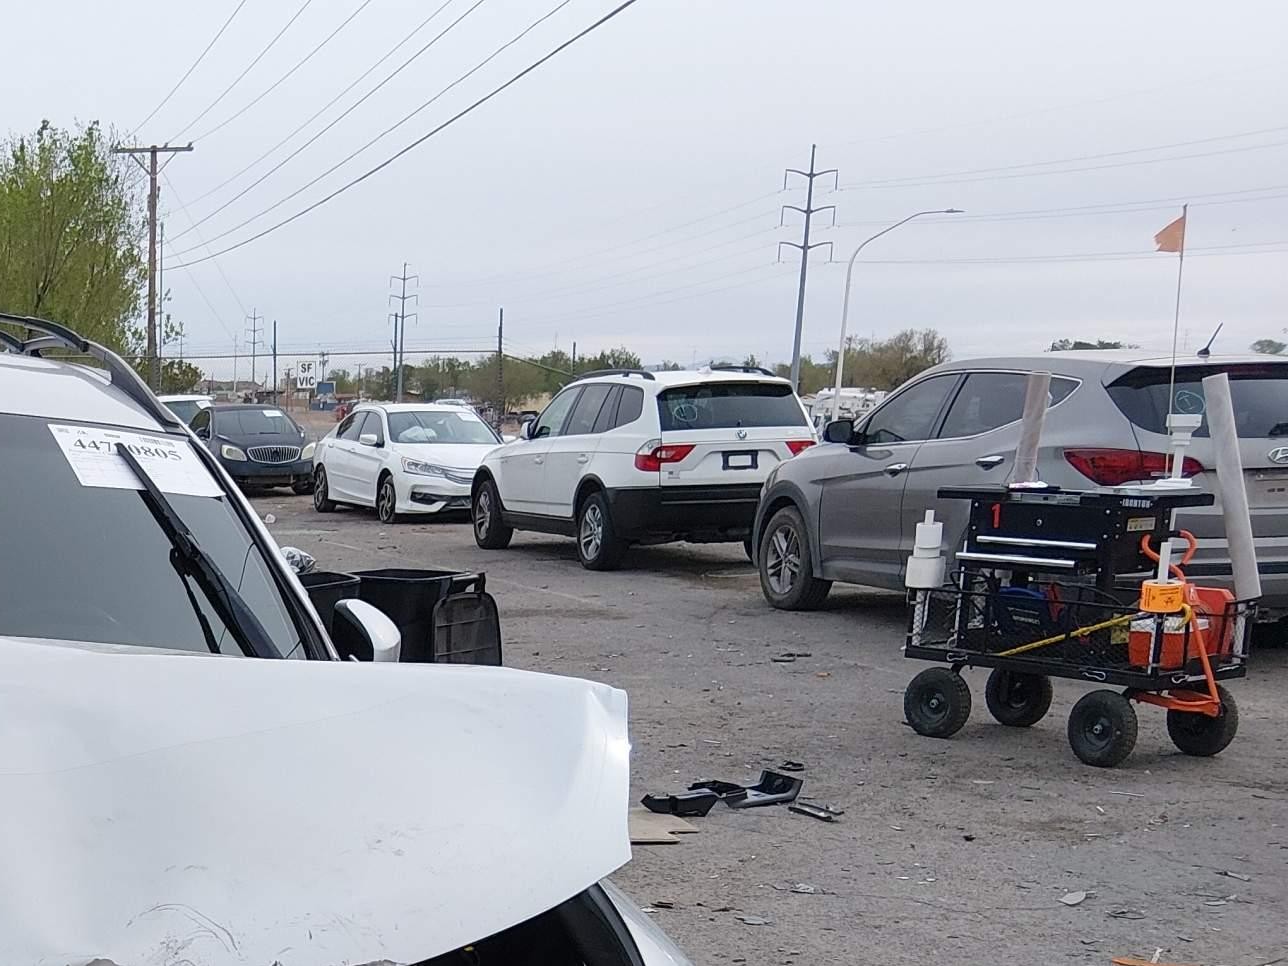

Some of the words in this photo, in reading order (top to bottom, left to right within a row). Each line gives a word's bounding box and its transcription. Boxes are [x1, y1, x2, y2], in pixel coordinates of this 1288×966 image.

[300, 363, 312, 373] SF
[298, 376, 315, 387] VIC
[73, 438, 183, 461] 4470805
[991, 503, 1001, 529] 1
